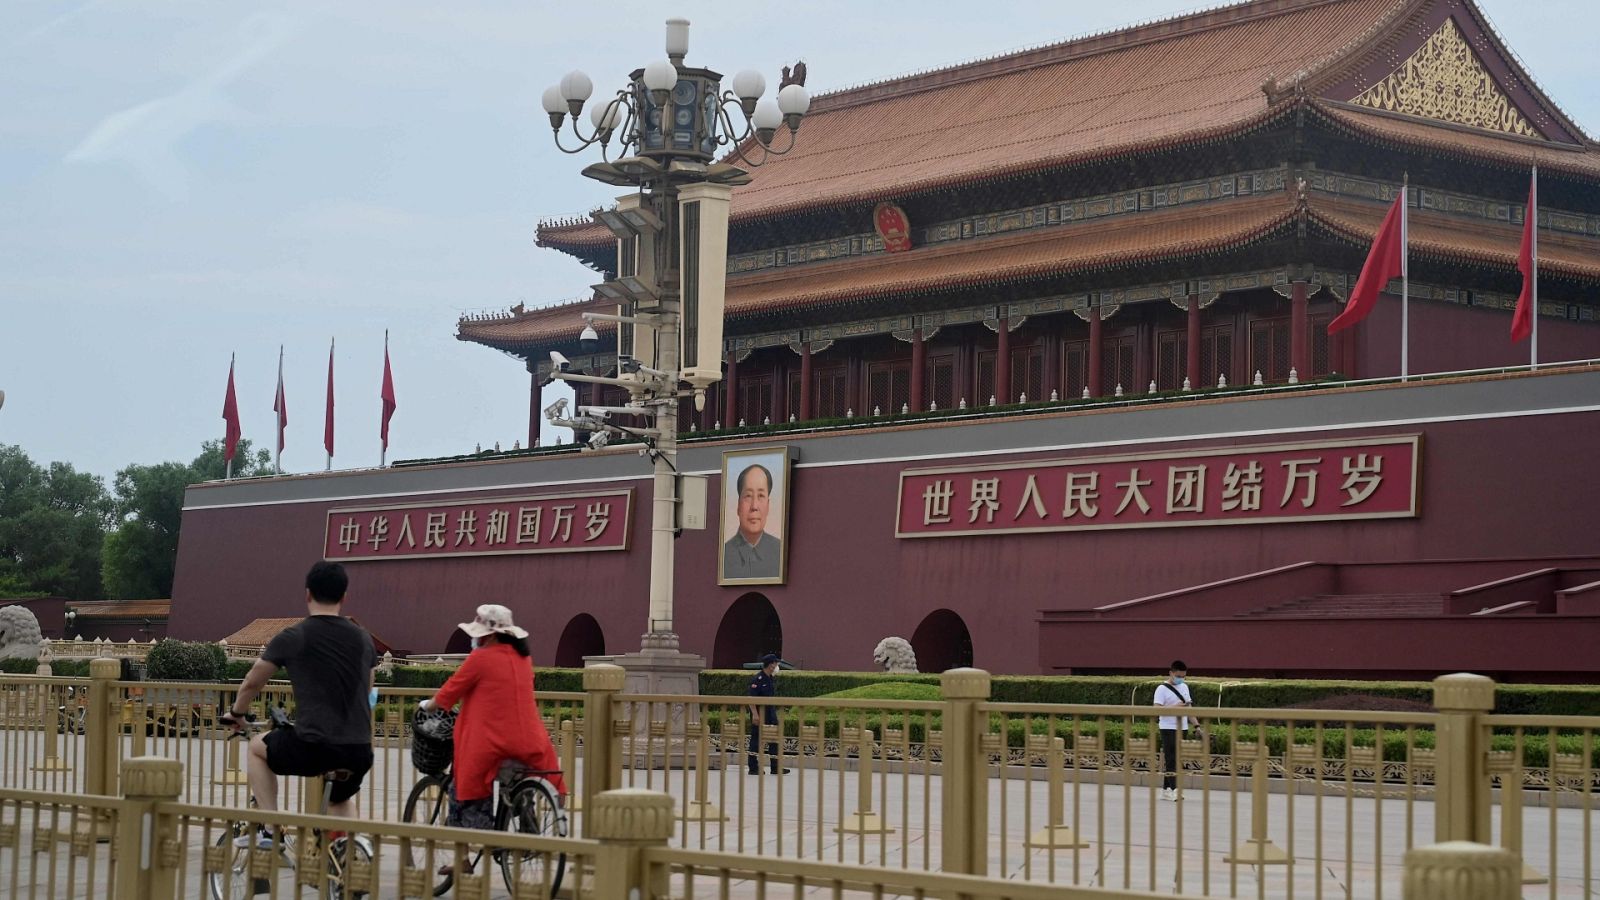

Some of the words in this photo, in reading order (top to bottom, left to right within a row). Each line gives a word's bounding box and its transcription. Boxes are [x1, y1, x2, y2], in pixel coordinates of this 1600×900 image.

[922, 453, 1385, 525] 世界人民大团结万岁
[339, 502, 611, 552] 中华人民共和国万岁
